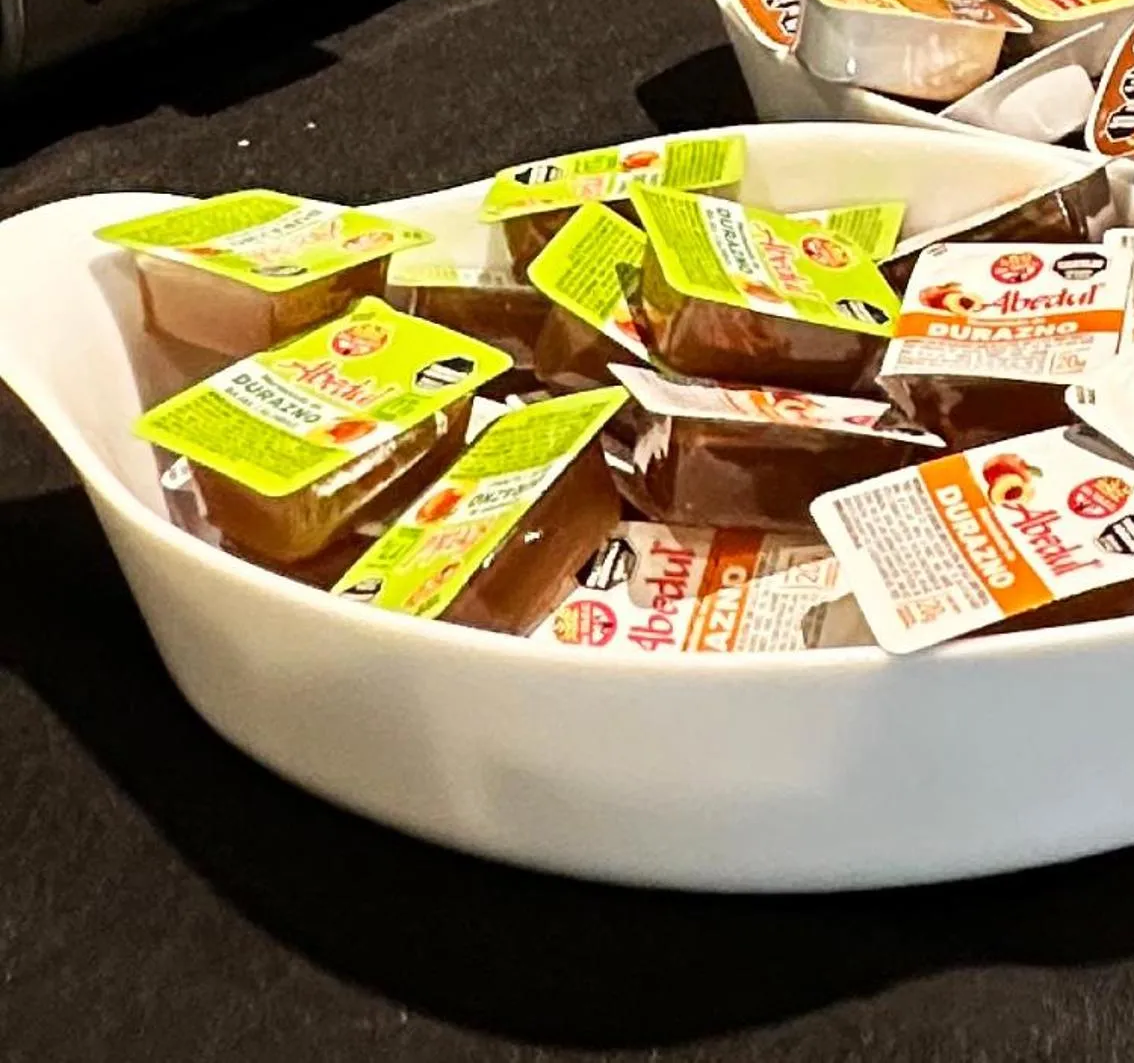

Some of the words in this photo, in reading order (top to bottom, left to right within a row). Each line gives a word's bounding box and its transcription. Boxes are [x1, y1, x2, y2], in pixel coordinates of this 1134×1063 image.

[982, 284, 1100, 315] Abedul
[926, 320, 1080, 341] DURAZNO
[230, 372, 322, 425] DURAZNO
[935, 482, 1016, 590] DURAZNO
[1002, 502, 1103, 577] Abedul
